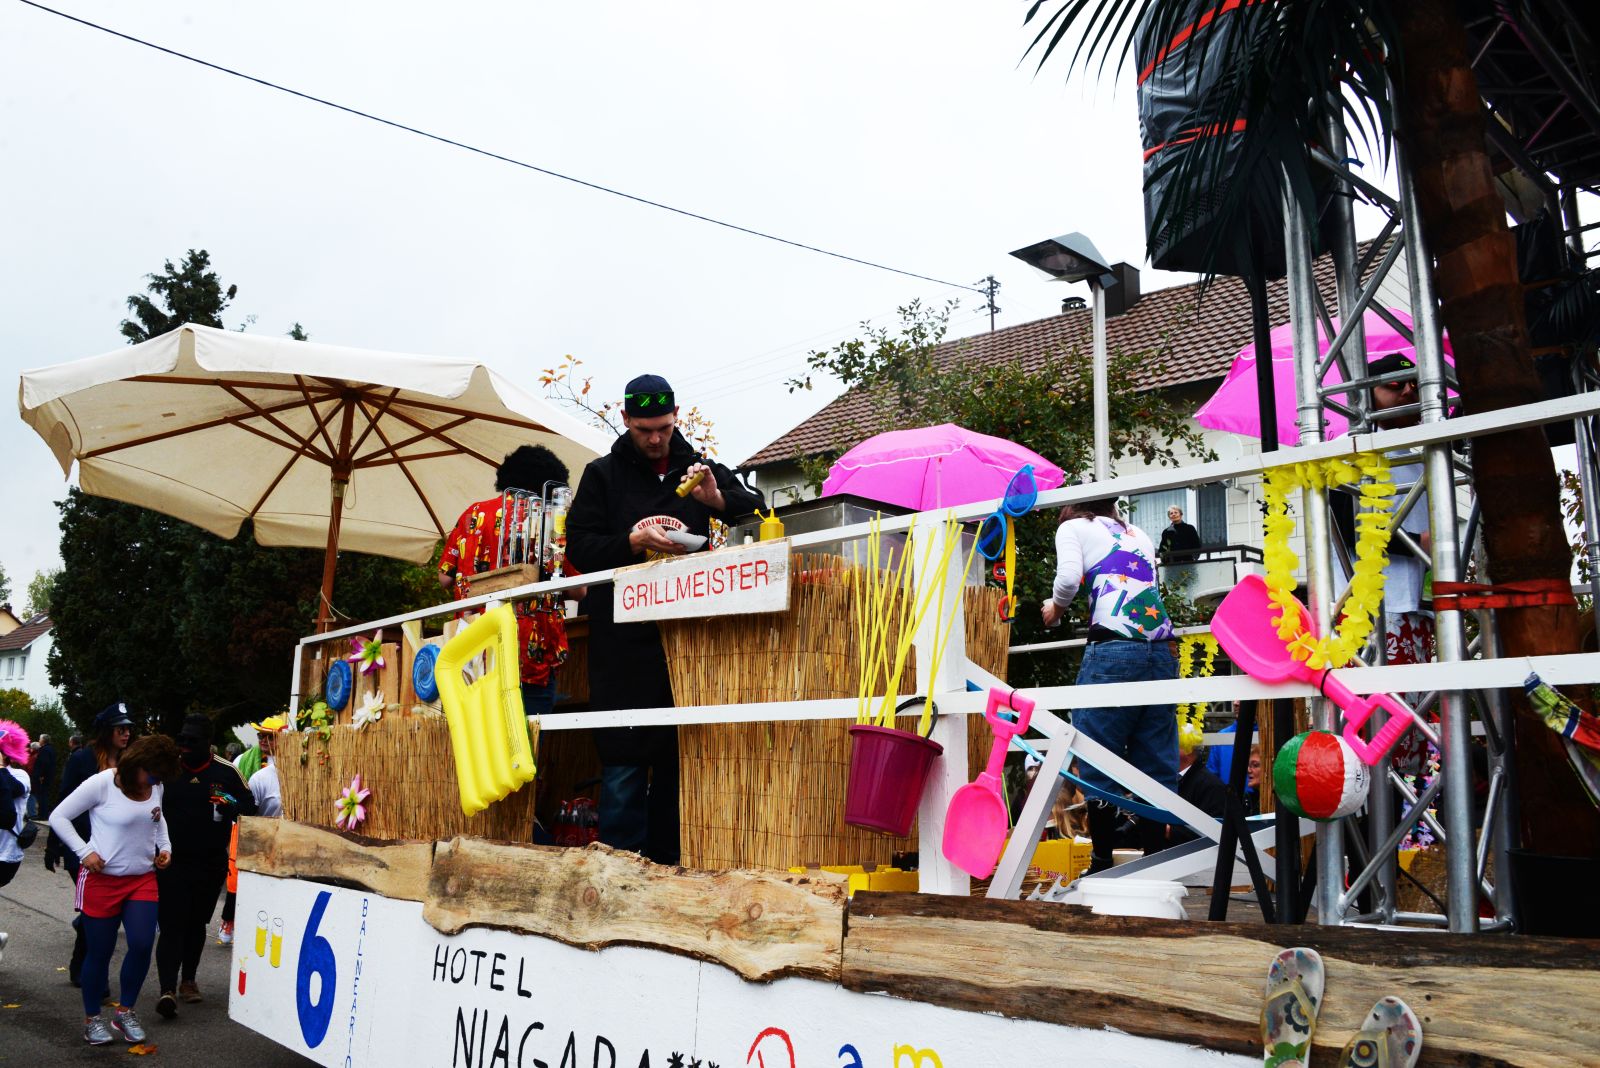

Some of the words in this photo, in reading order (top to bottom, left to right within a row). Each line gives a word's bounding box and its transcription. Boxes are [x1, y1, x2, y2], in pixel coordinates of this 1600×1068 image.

[623, 560, 769, 610] GRILLMEISTER
[296, 890, 337, 1049] 6
[433, 943, 533, 999] HOTEL
